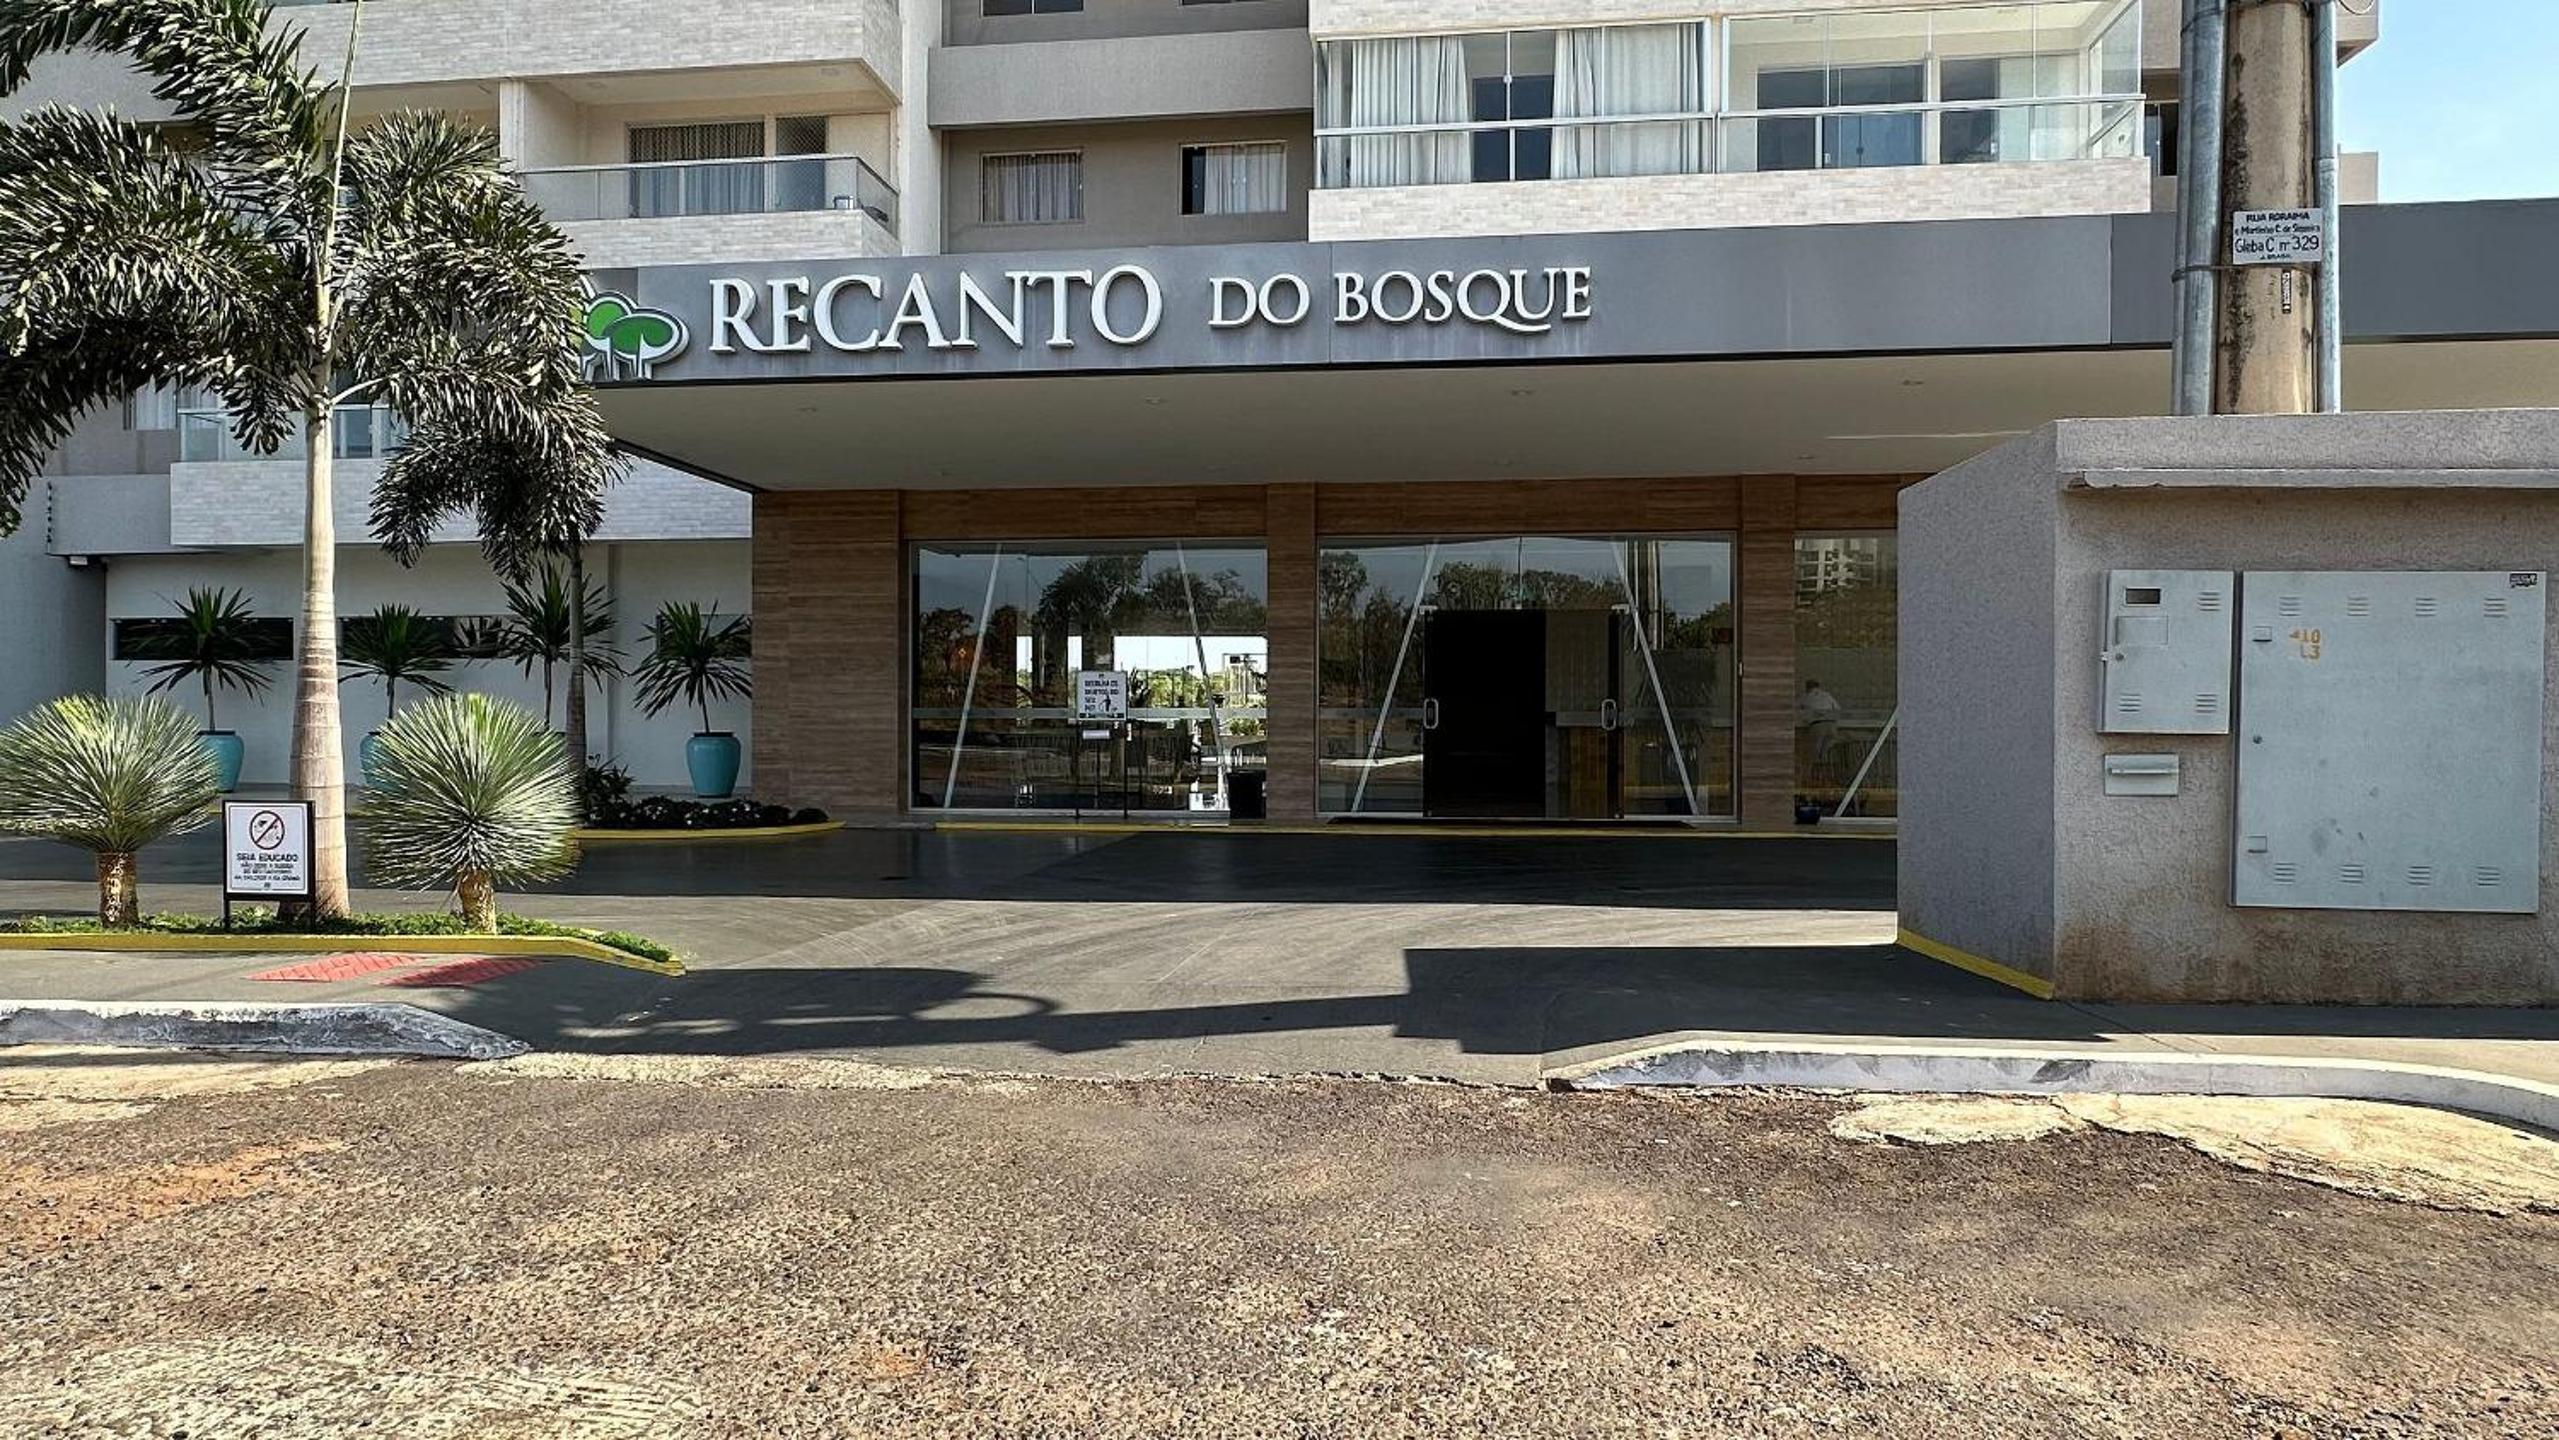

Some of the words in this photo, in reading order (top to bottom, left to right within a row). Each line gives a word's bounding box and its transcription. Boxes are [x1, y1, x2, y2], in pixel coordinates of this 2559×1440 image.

[2234, 238, 2264, 253] Gleba
[2265, 236, 2275, 253] C
[2291, 234, 2319, 251] 329
[709, 264, 1163, 352] RECANTO
[1208, 272, 1311, 328] DO
[1333, 266, 1592, 333] BOSQUE
[259, 852, 299, 862] EDUCADO
